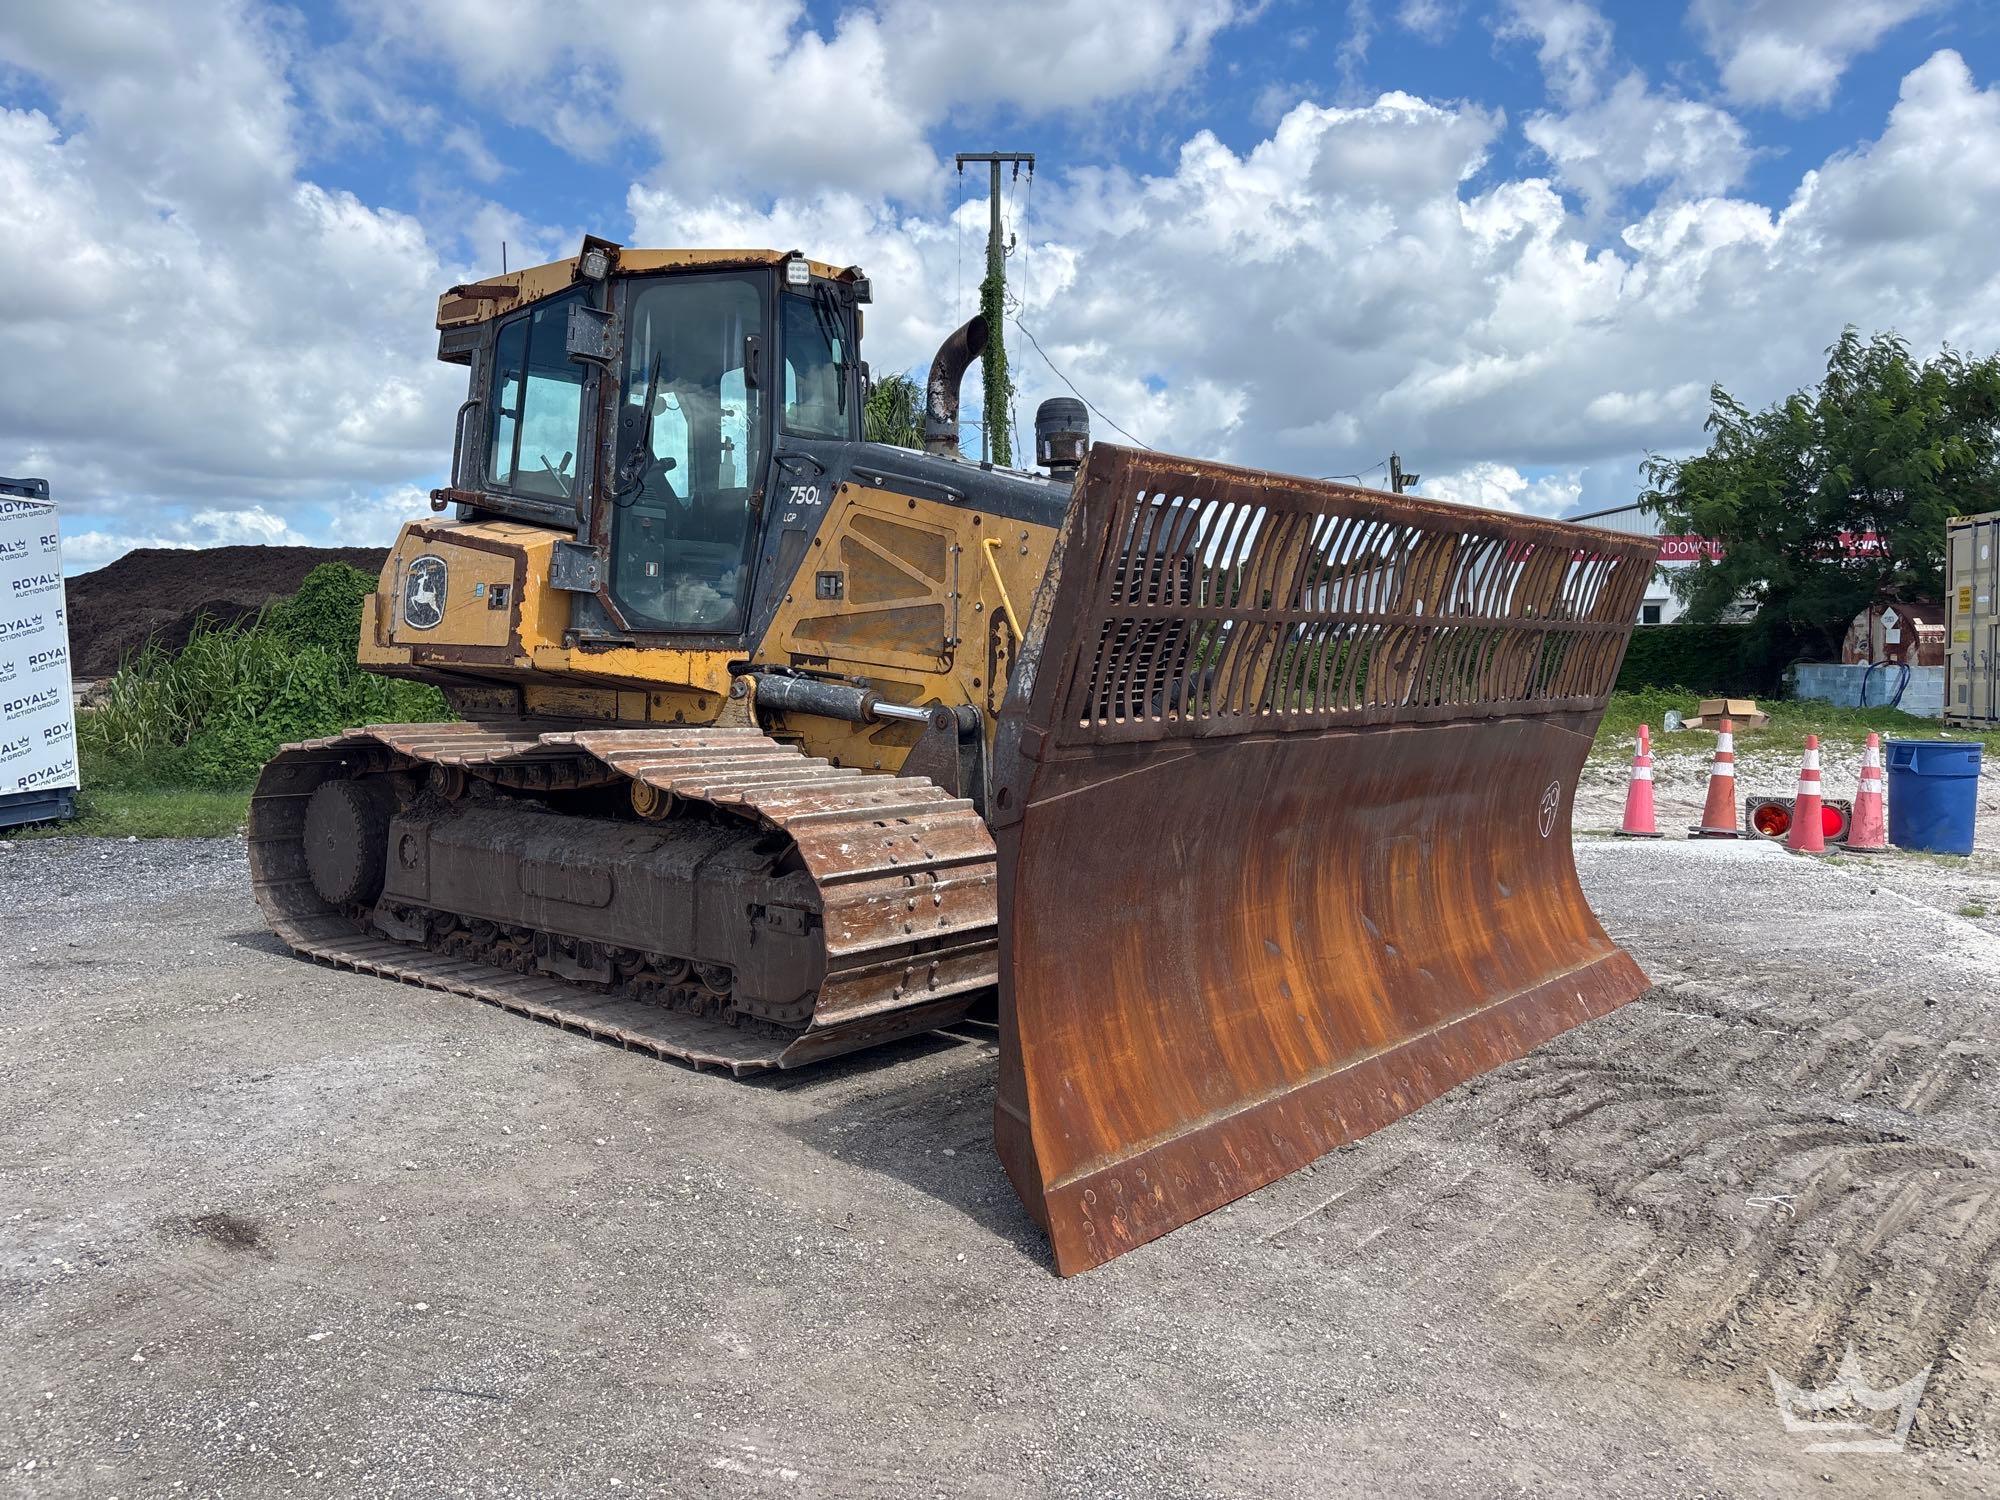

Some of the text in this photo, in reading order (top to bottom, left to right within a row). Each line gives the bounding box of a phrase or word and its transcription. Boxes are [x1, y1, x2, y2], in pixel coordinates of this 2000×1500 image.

[788, 485, 821, 505] 750L
[29, 508, 52, 518] GROUP
[783, 512, 797, 522] LGP
[5, 551, 29, 561] GROUP
[12, 573, 55, 591] ROYAL
[15, 583, 60, 599] AUCTION GRO
[22, 625, 45, 637] GROUP
[31, 659, 60, 673] AUCTION
[4, 692, 47, 714] ROYAL
[7, 698, 60, 721] AUCTION GROUP
[7, 747, 32, 761] GROUP
[18, 764, 62, 788] ROYAL
[52, 769, 75, 783] GROUP
